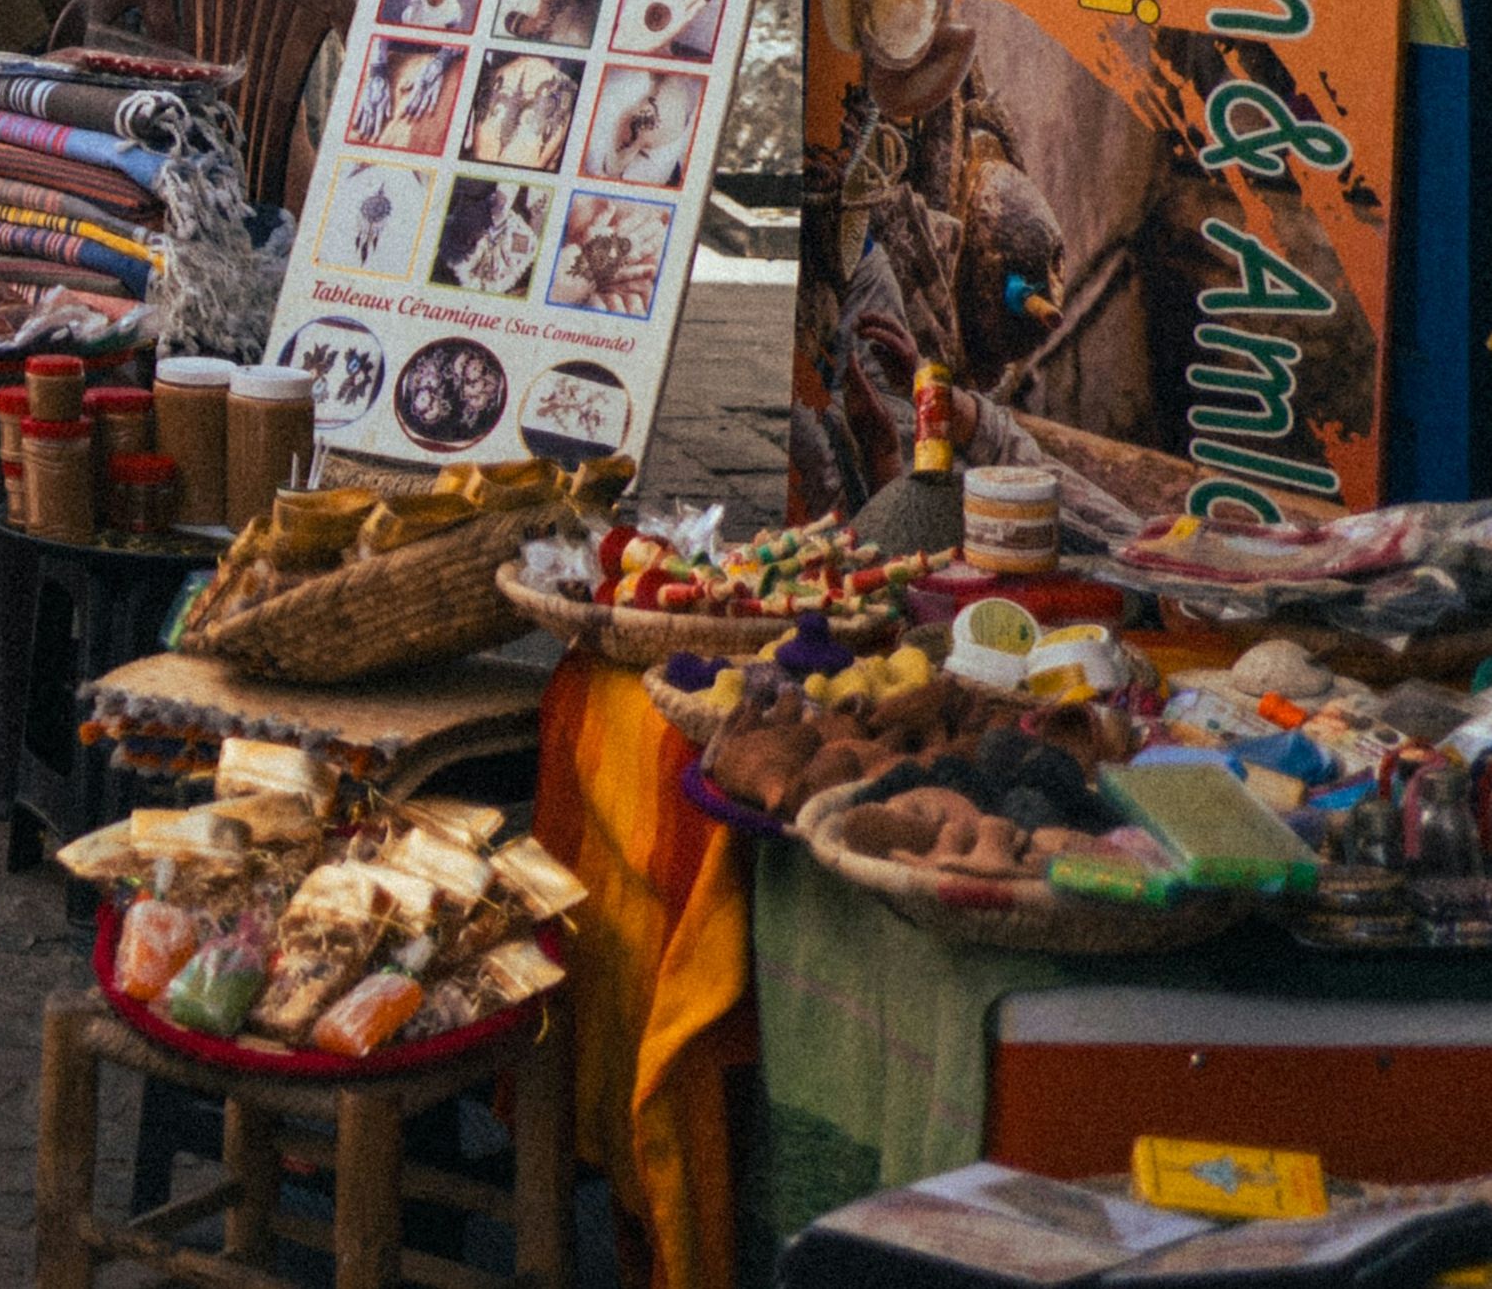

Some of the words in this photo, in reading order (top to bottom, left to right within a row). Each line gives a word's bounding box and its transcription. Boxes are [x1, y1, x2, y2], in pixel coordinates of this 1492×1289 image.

[1197, 78, 1351, 180] &
[312, 280, 393, 312] Tableaux
[398, 293, 501, 332] Céramique
[505, 317, 539, 337] (Sur
[542, 324, 635, 354] Commande)
[1183, 217, 1340, 526] Amlo
